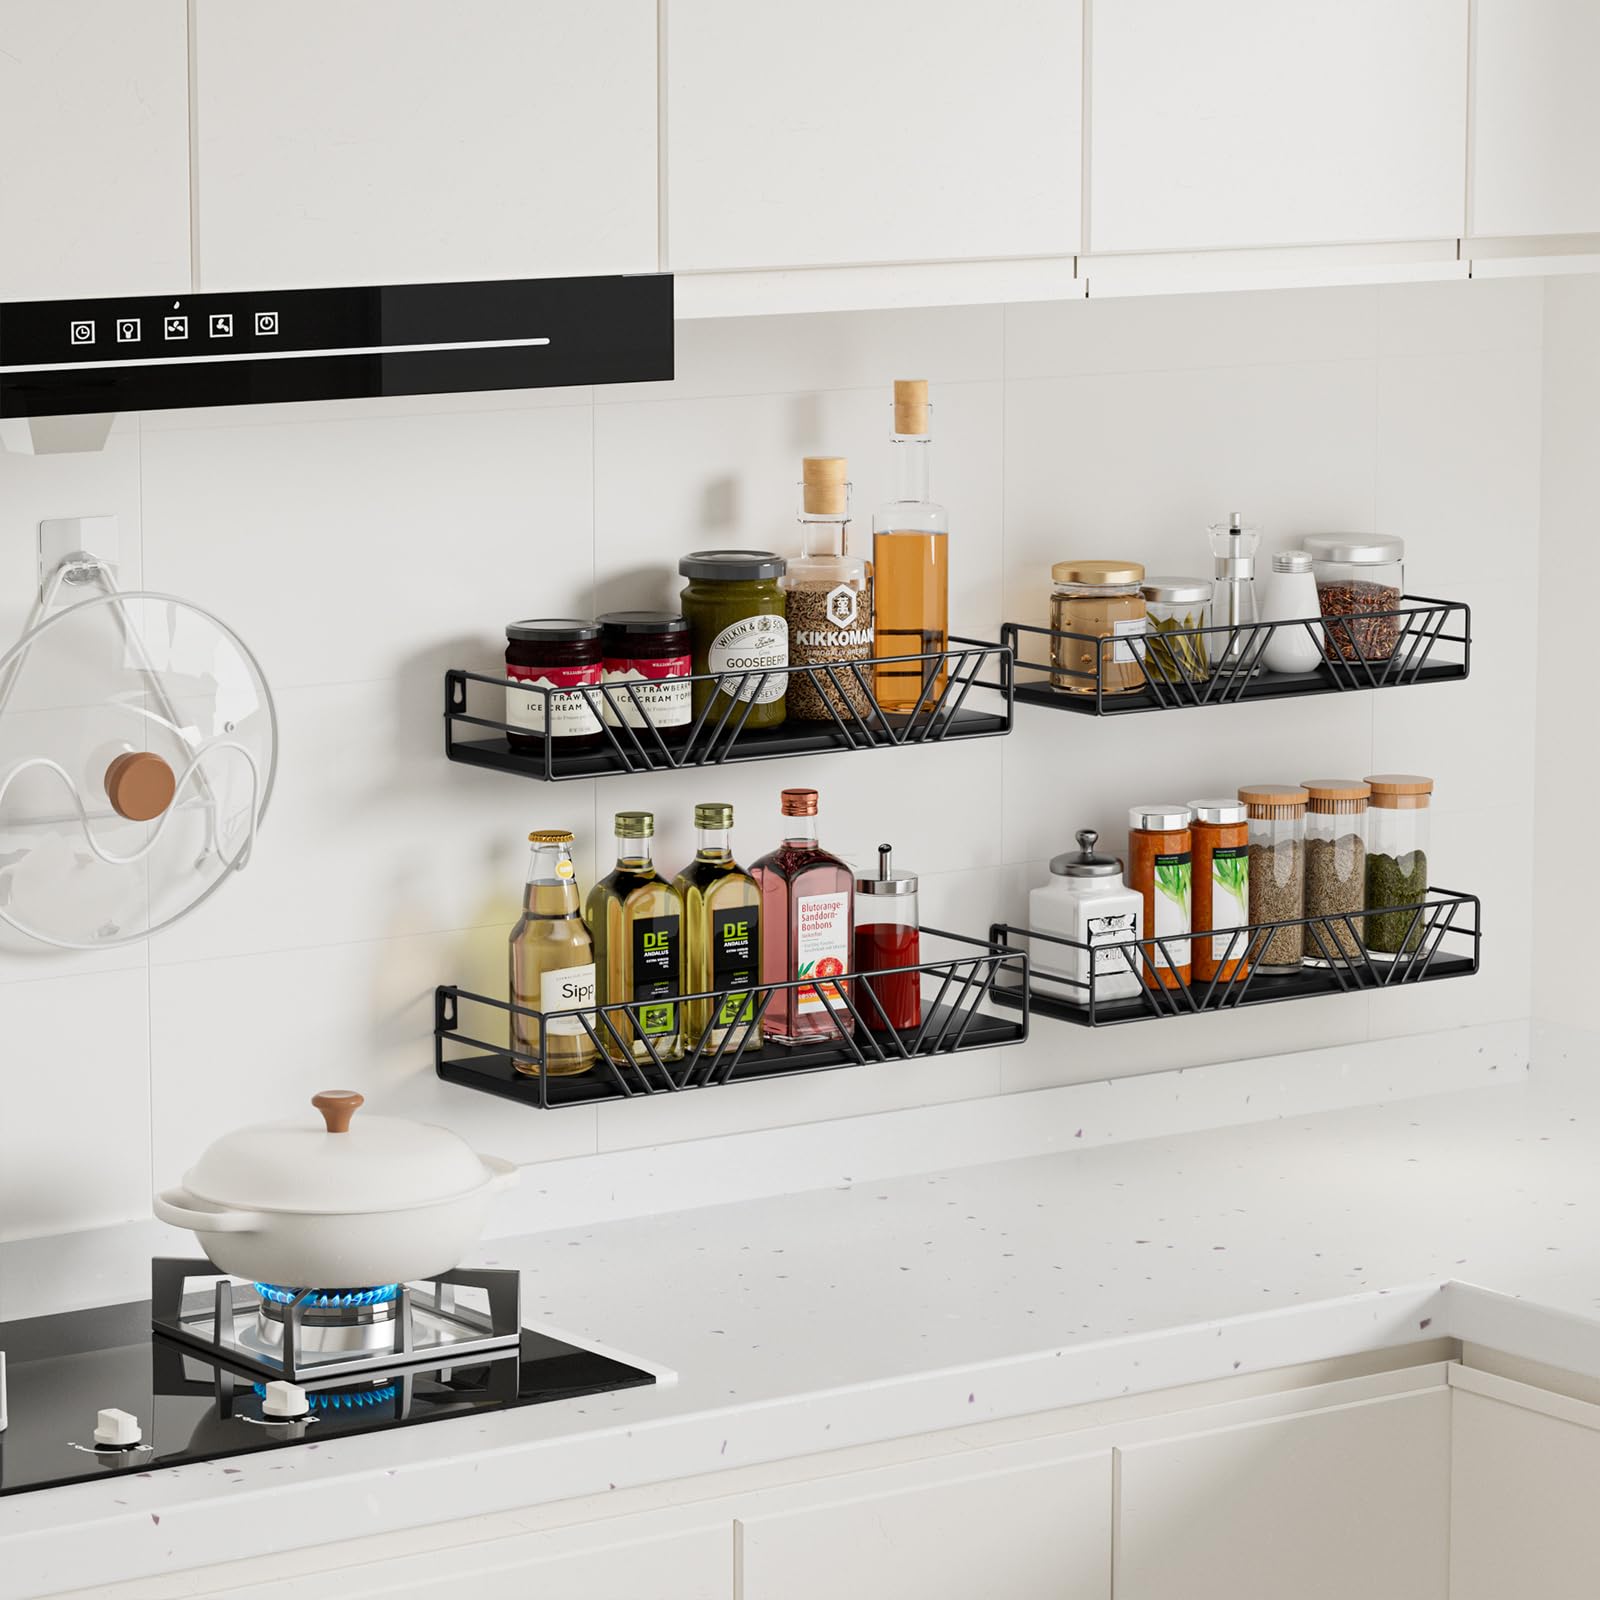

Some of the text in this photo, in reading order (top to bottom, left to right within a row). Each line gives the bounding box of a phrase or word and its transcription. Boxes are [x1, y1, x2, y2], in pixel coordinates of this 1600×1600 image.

[719, 625, 747, 647] WILKIN
[749, 622, 756, 631] &
[796, 629, 874, 646] KIKKOMAN
[726, 654, 786, 669] GOOSEBERR
[616, 695, 633, 703] ICE
[639, 695, 672, 704] CREAM
[527, 703, 582, 712] ICE CREAM
[802, 902, 844, 913] Blutorange-
[802, 912, 838, 923] Sanddorn-
[723, 921, 749, 939] DE
[802, 921, 833, 932] Bonbons
[643, 931, 669, 948] DE
[723, 940, 749, 948] ANDALUS
[562, 984, 594, 1002] Sipp
